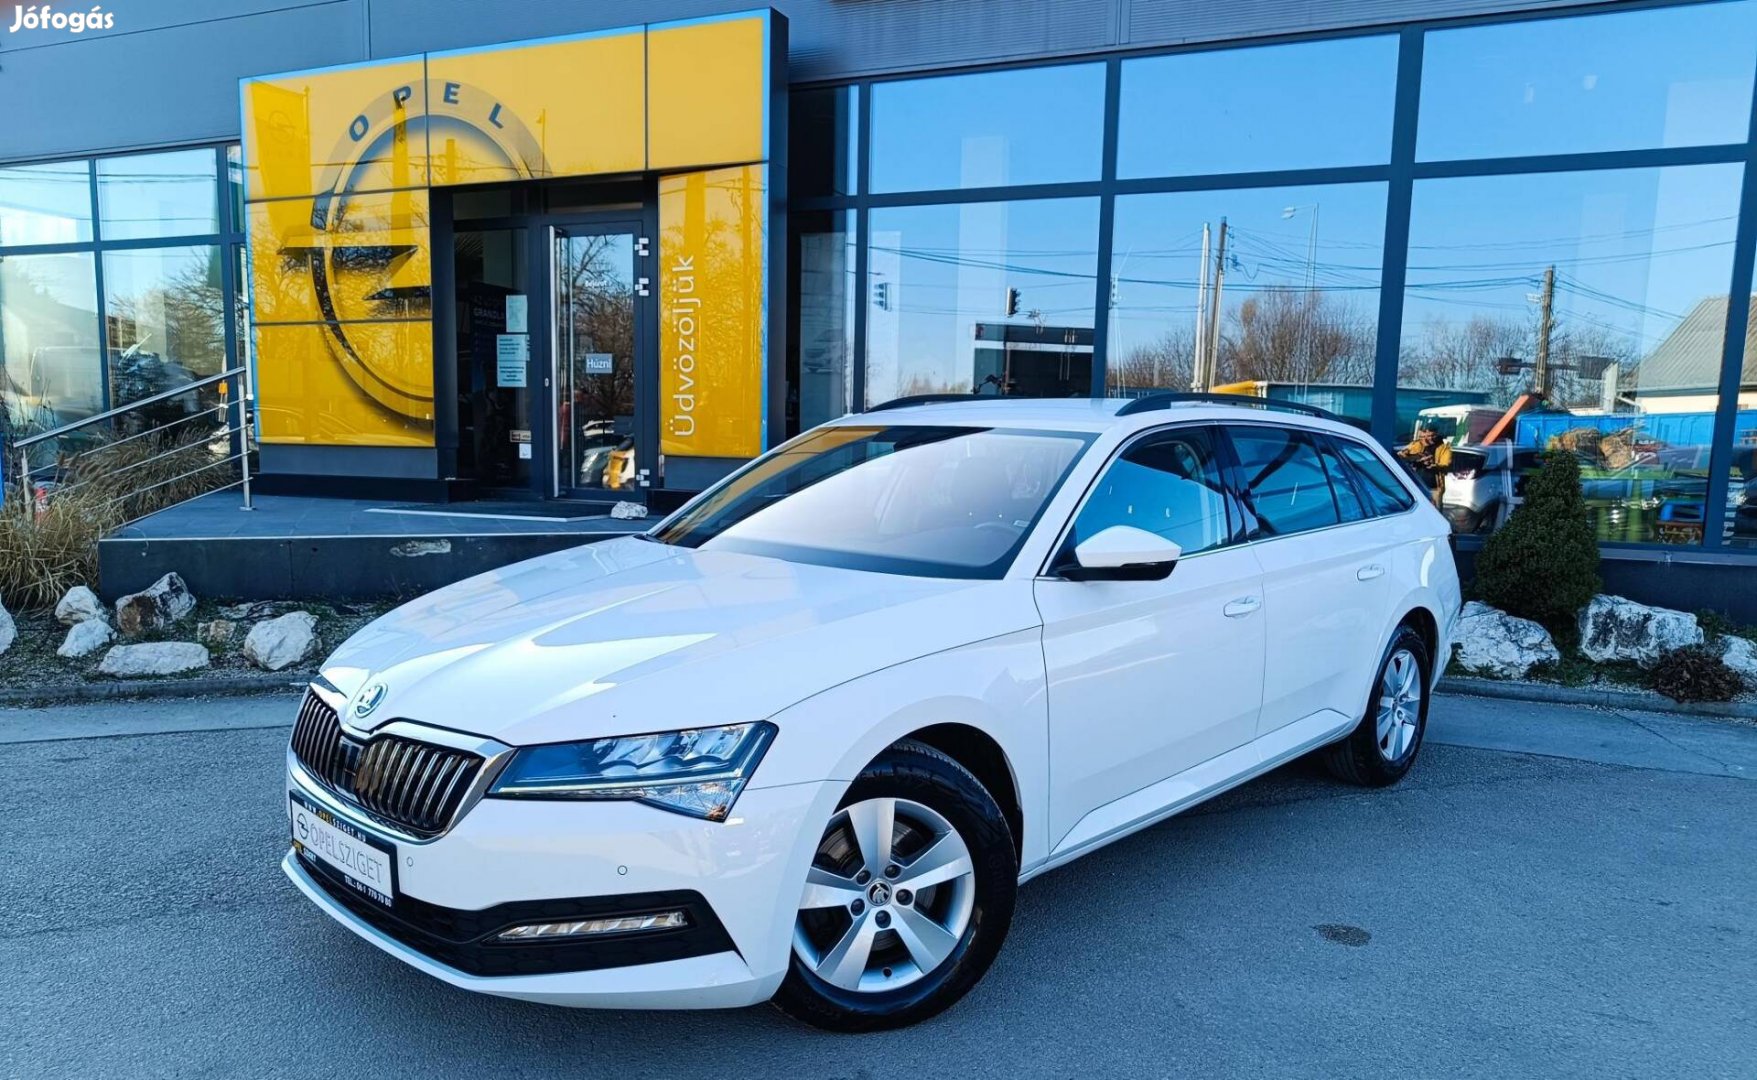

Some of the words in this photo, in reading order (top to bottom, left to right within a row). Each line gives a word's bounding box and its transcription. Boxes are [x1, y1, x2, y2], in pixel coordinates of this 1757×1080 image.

[349, 82, 504, 142] OPEL
[586, 358, 612, 369] Húzni
[669, 255, 701, 436] Üdvözöljük
[310, 823, 382, 884] OPELSZIGET
